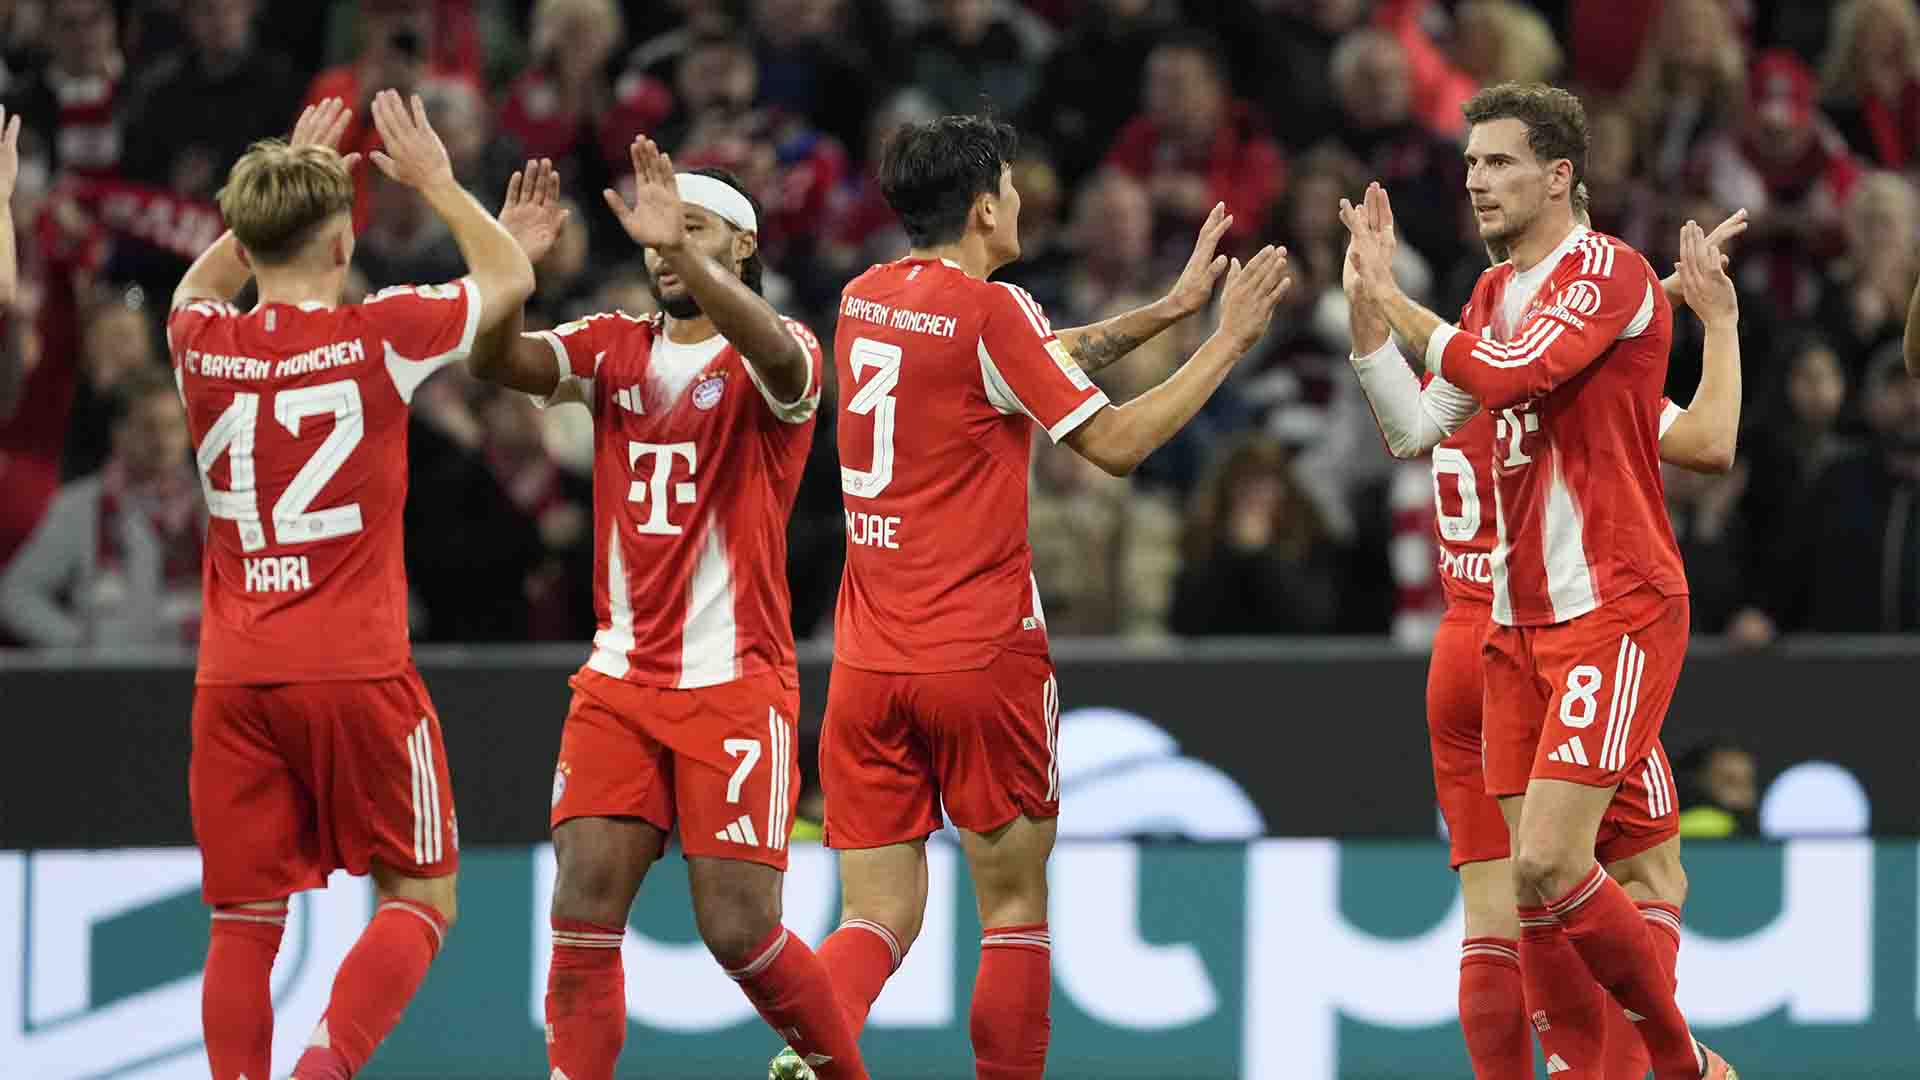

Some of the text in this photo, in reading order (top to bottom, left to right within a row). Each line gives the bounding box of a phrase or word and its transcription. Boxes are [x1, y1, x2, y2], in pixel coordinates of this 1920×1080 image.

[845, 295, 890, 325] BAYERN
[200, 352, 273, 380] BAYERN
[841, 336, 903, 499] 3
[196, 379, 364, 552] 42
[627, 440, 697, 535] T
[243, 555, 313, 593] KARL
[1559, 665, 1603, 729] 8
[723, 738, 761, 804] 7
